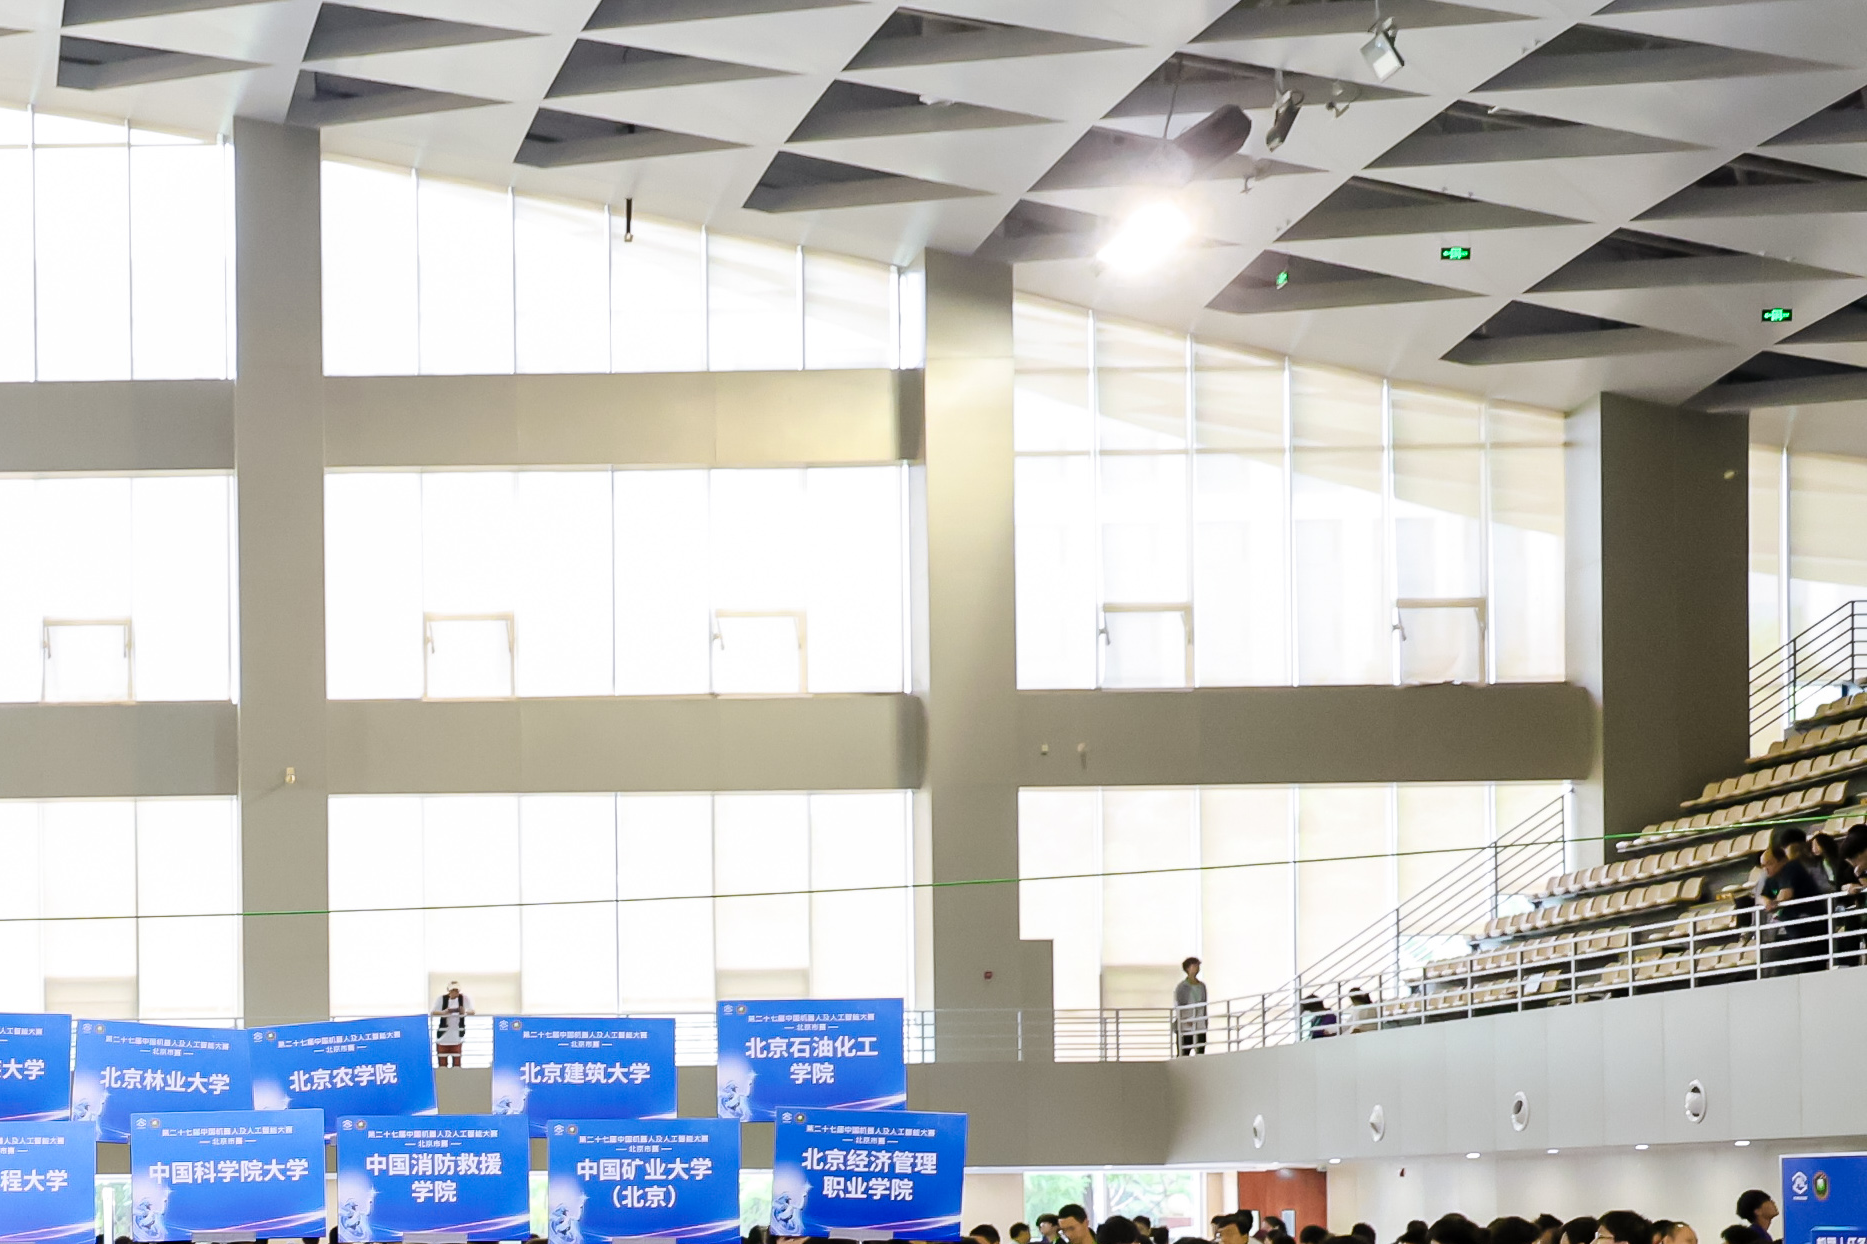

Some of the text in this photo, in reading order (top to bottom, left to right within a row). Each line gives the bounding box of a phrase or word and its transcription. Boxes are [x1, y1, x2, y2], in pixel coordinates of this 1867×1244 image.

[746, 1036, 878, 1058] 北京石油化工
[98, 1067, 229, 1096] 北京林业大学
[289, 1063, 398, 1092] 北京农学院
[518, 1062, 650, 1087] 北京建筑大学
[790, 1062, 834, 1084] 学院
[147, 1159, 308, 1186] 中国科学院大学
[366, 1153, 501, 1175] 中国消防救援
[577, 1158, 712, 1181] 中国矿业大学
[799, 1148, 936, 1177] 北京经济管理
[412, 1180, 456, 1202] 学院
[823, 1176, 913, 1200] 职业学院
